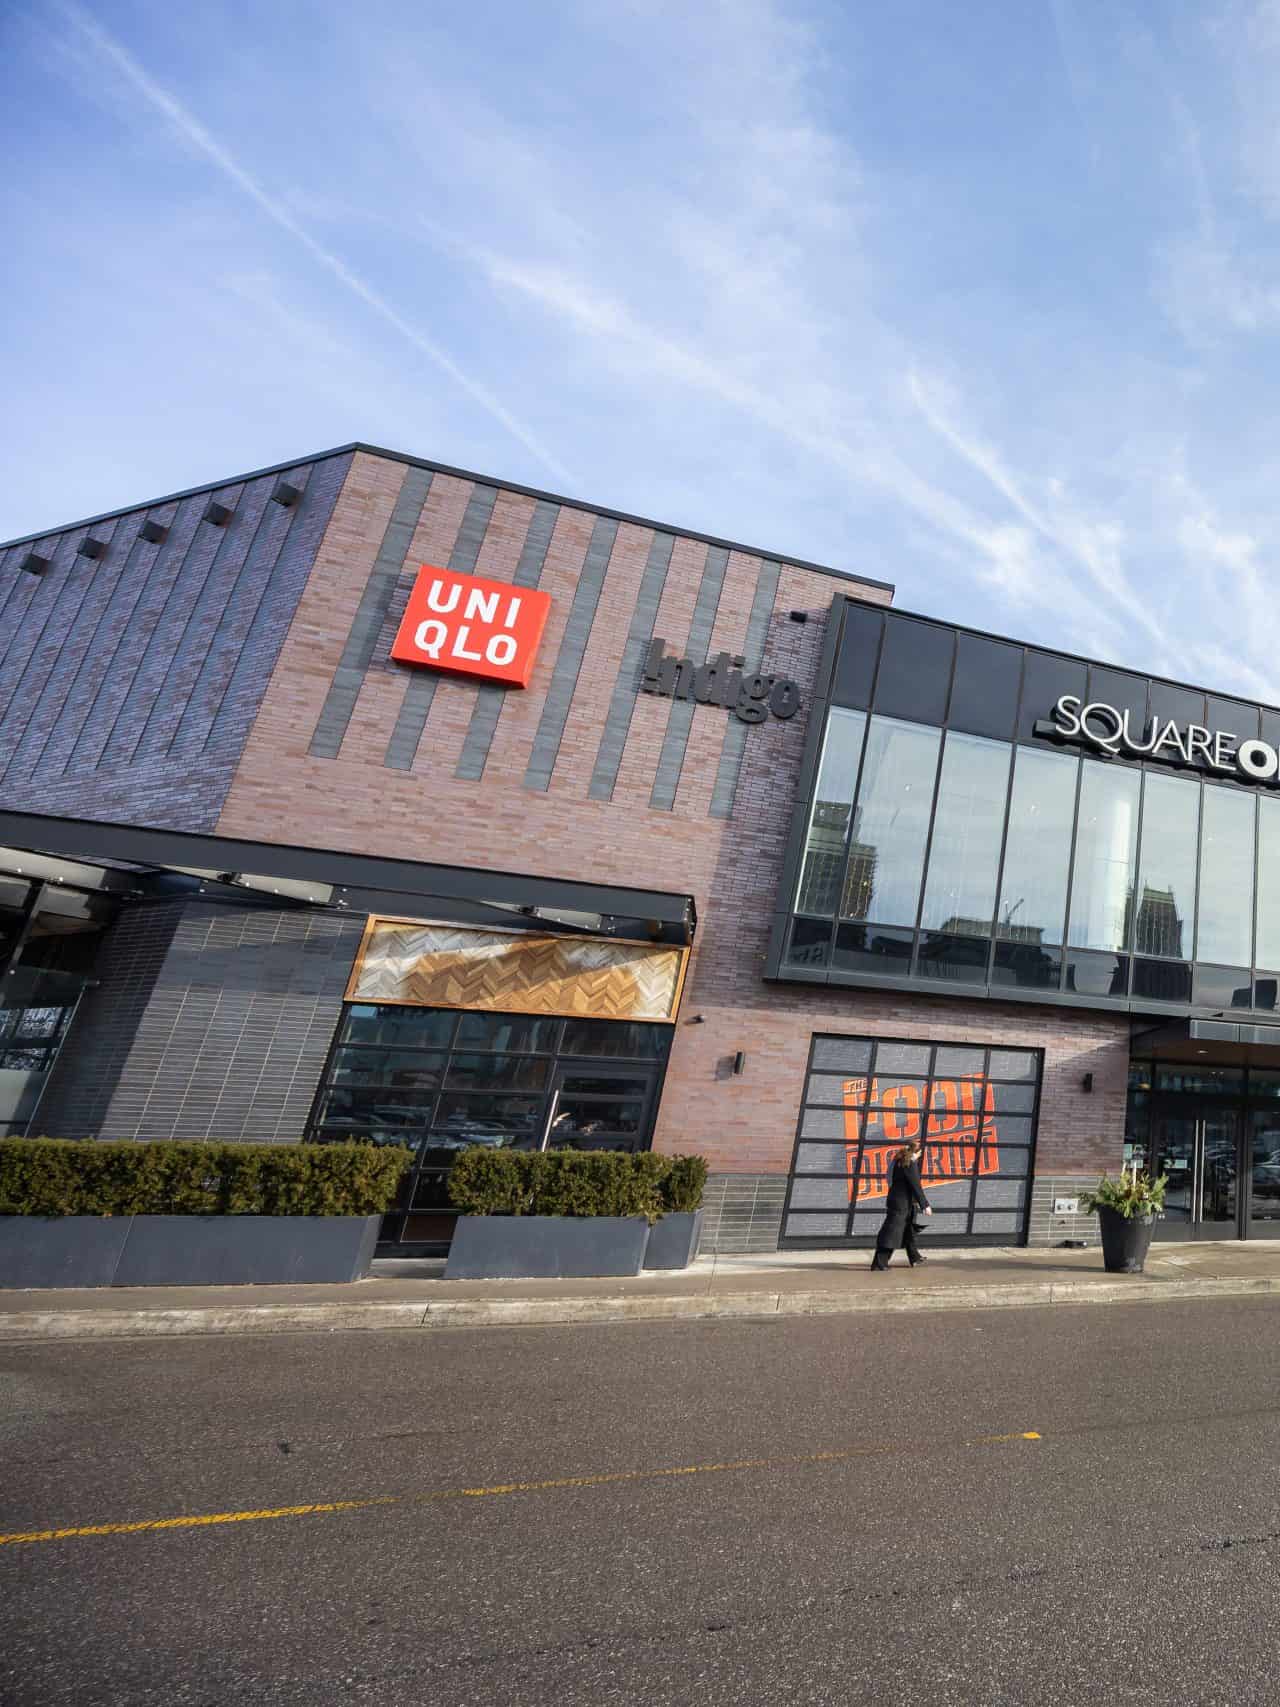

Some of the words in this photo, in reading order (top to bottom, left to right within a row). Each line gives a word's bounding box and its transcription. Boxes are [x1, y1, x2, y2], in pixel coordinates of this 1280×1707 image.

[427, 579, 522, 629] UNI
[414, 619, 518, 666] QLO
[1055, 695, 1237, 771] SQUARE
[843, 1073, 995, 1149] FOOD
[850, 1129, 994, 1197] DIRICT
